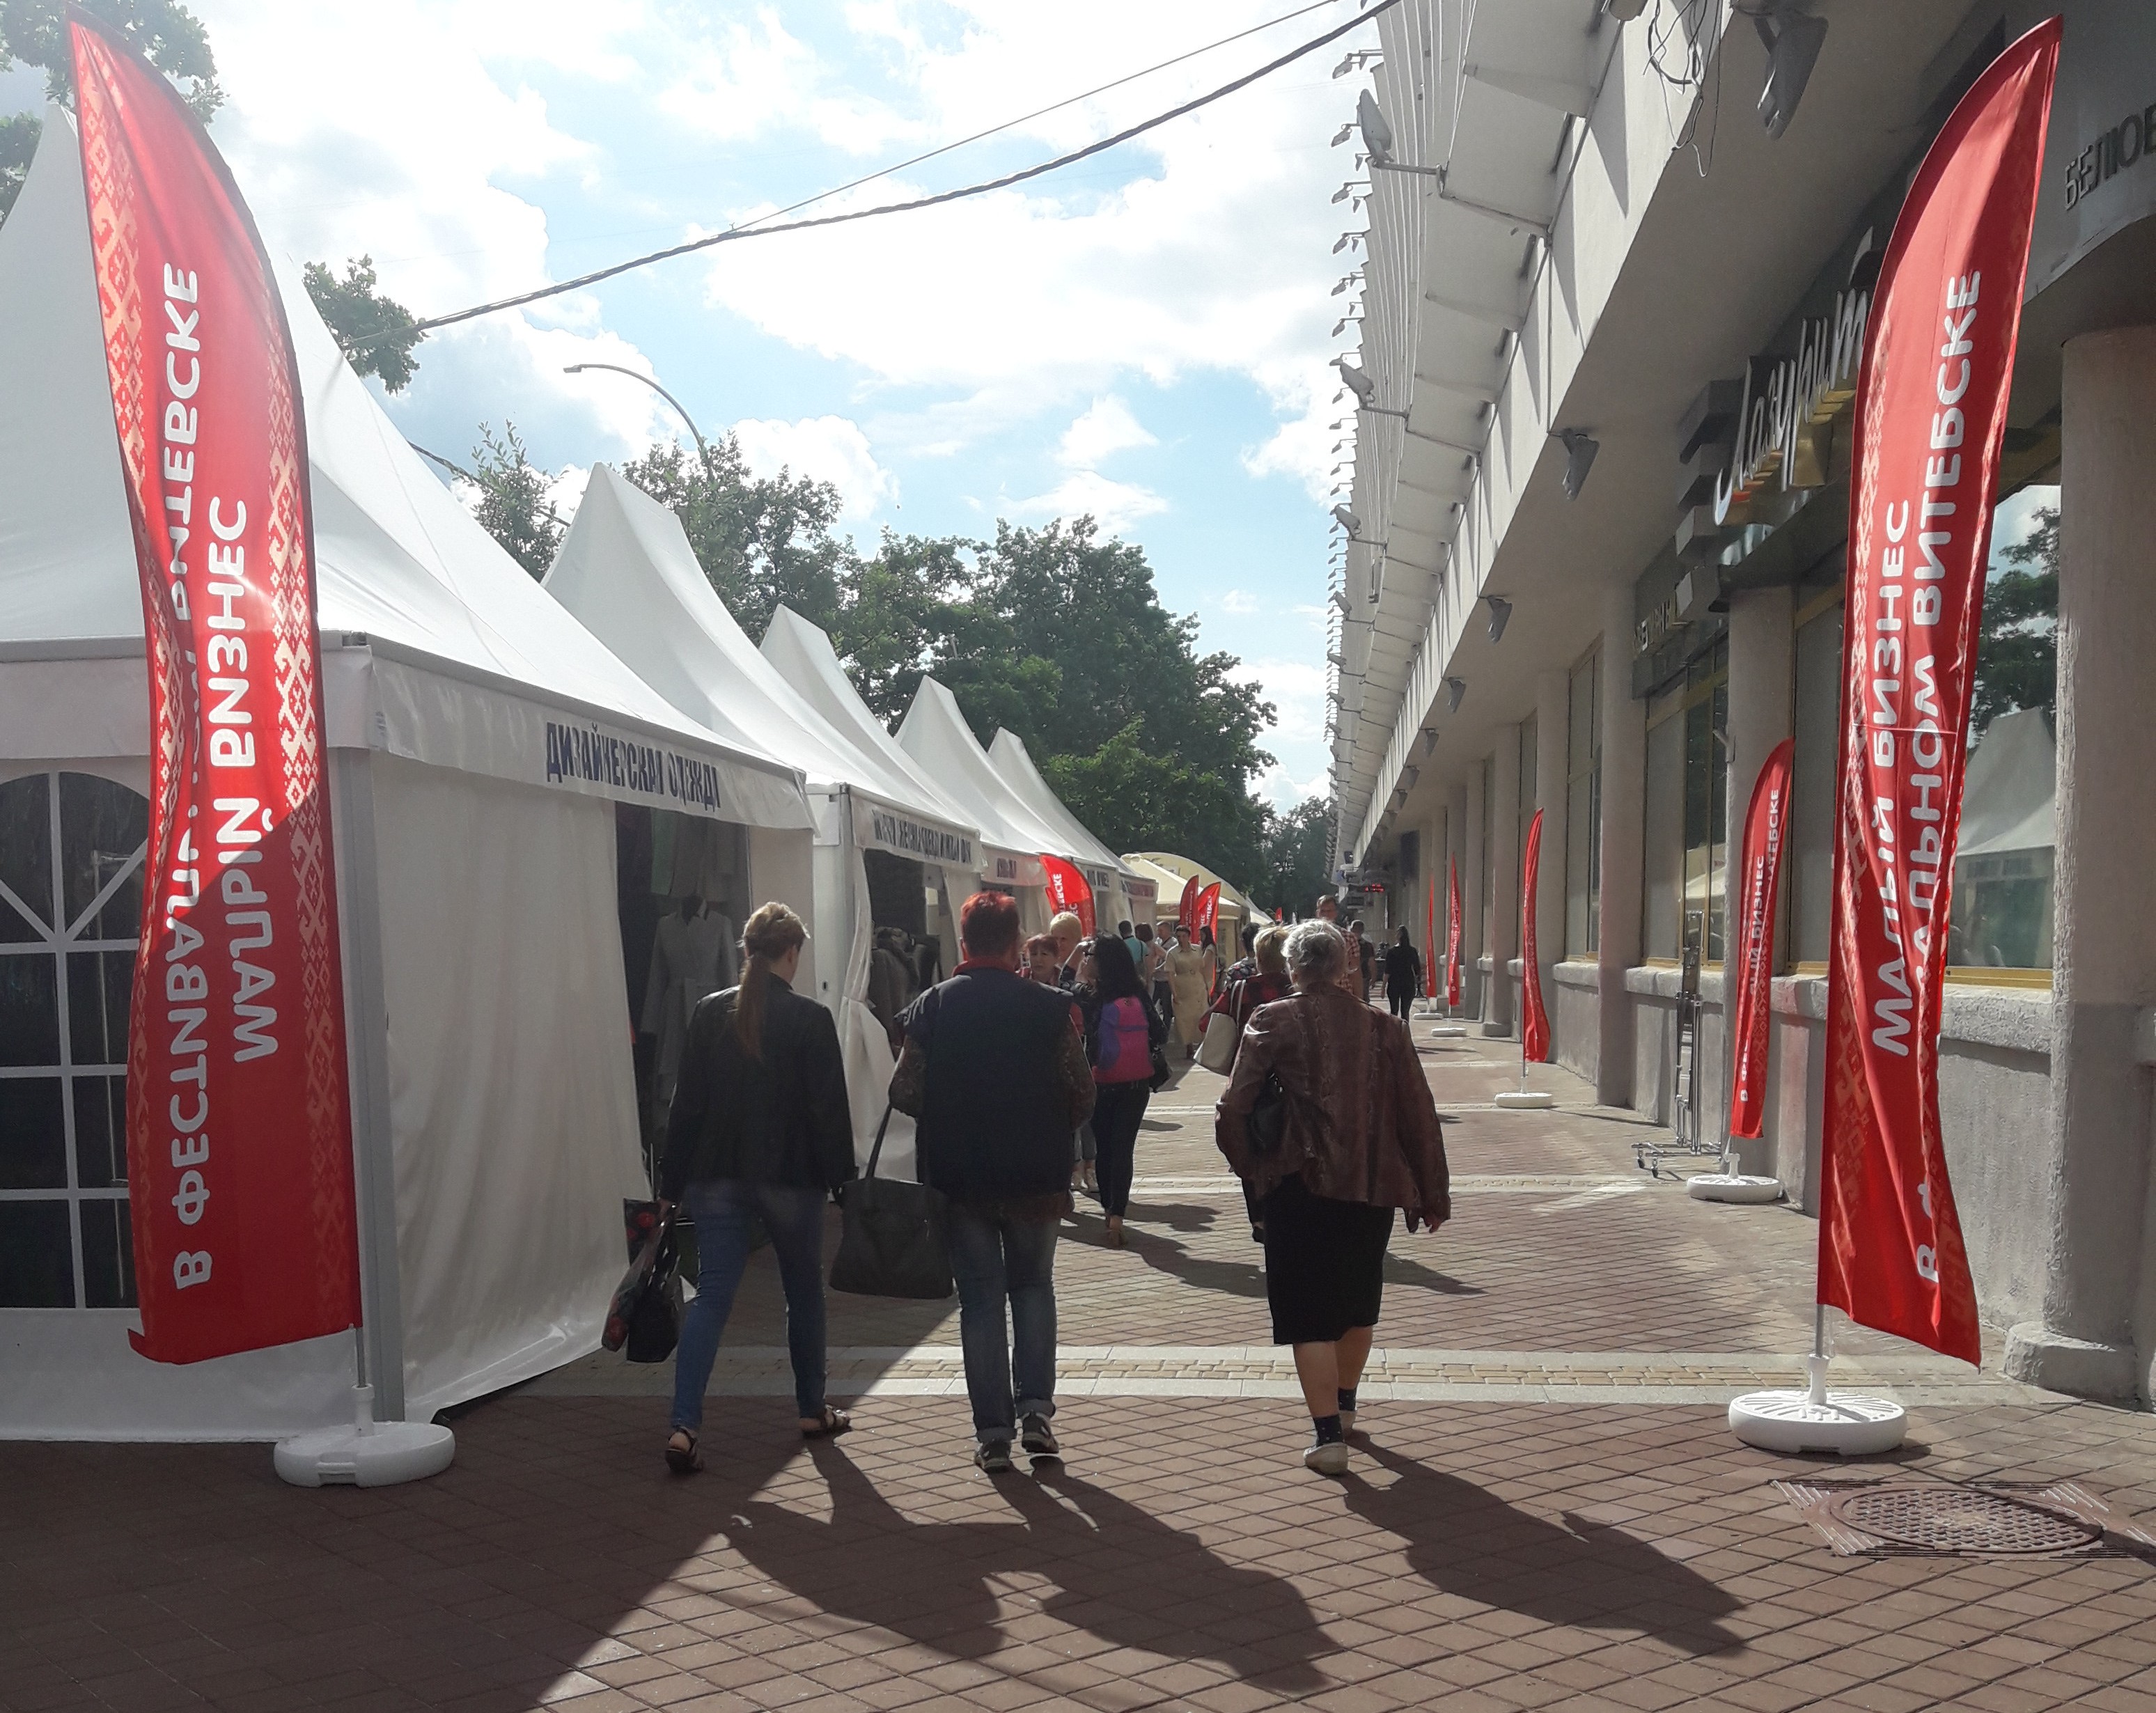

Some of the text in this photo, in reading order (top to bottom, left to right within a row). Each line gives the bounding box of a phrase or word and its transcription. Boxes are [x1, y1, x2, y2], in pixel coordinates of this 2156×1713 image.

[1913, 270, 1982, 626] ВИТЕБСКЕ
[1767, 789, 1779, 882] ТЕБСКЕ
[1871, 499, 1913, 1057] МАЛЫЙ БИЗНЕС
[1751, 855, 1765, 940] БИЗНЕС
